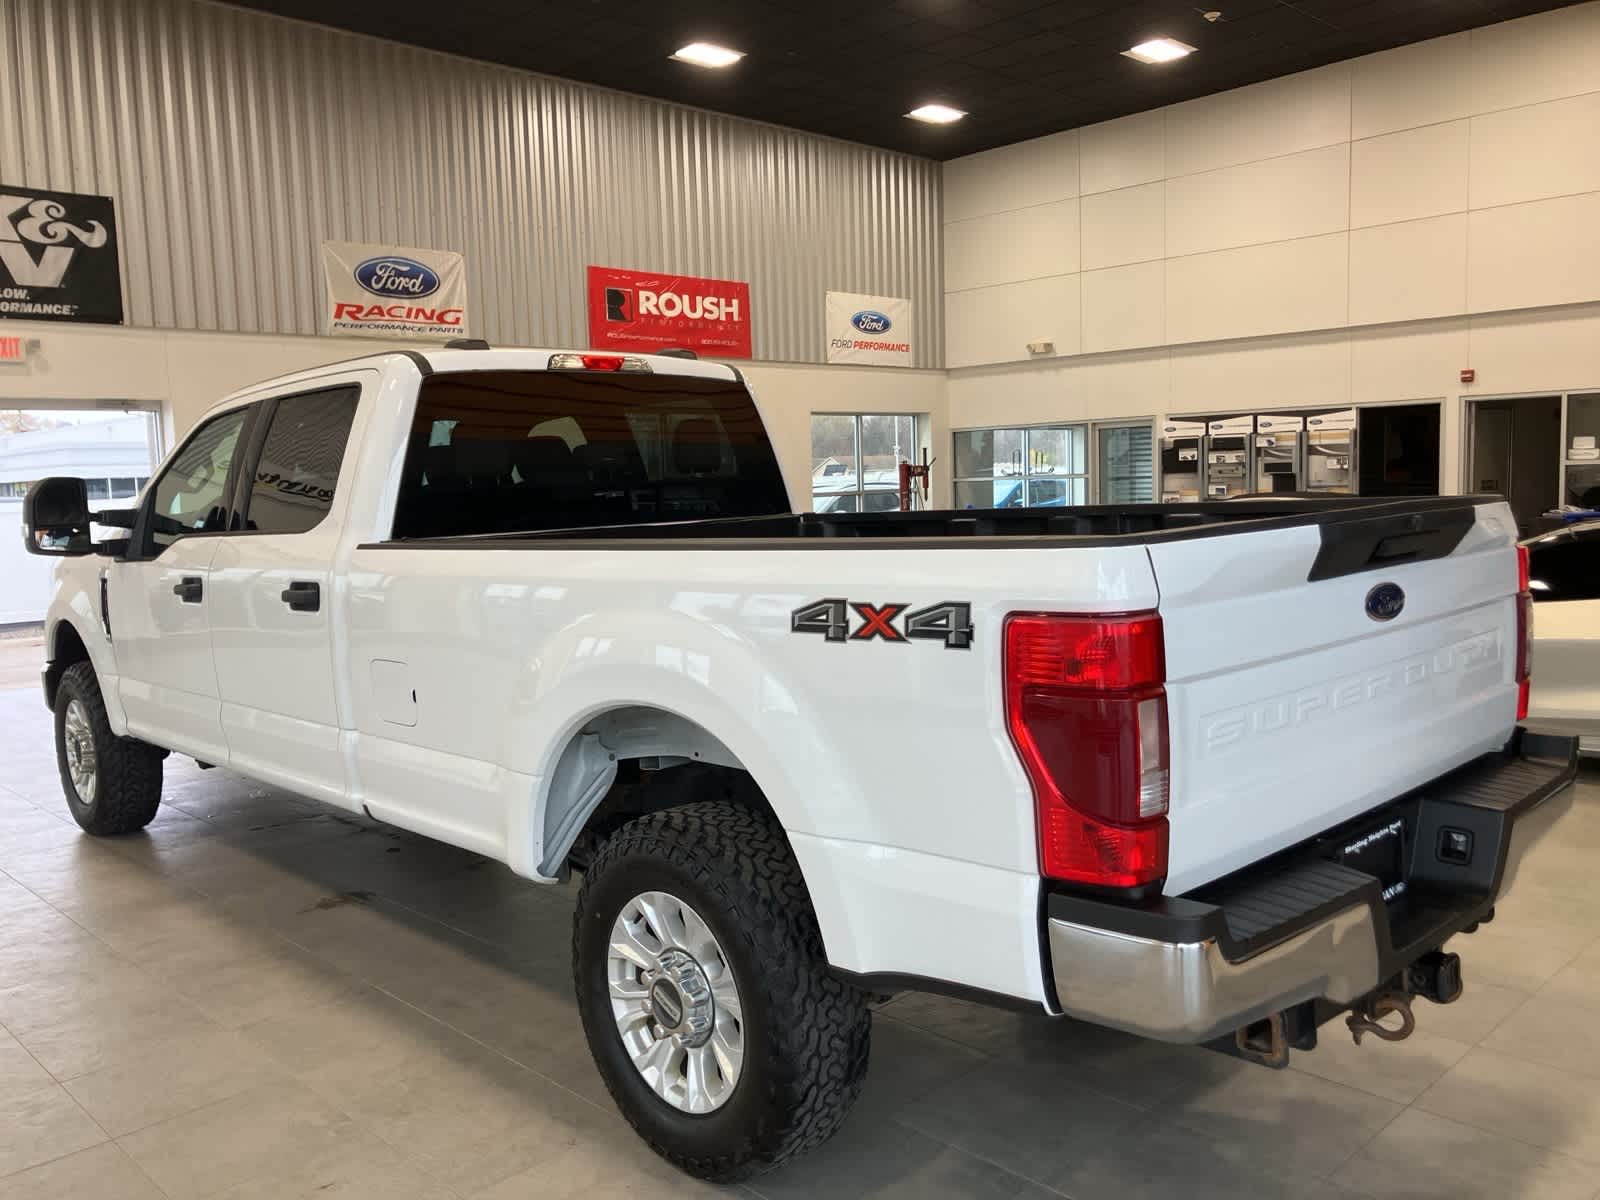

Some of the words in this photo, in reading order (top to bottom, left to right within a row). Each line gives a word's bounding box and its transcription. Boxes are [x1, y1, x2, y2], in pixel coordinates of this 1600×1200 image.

[371, 262, 424, 293] Ford
[334, 303, 464, 325] RACING
[638, 290, 740, 321] ROUSH
[334, 322, 425, 333] PERFORMANCE
[429, 326, 464, 334] PARTS
[859, 314, 884, 330] Ford
[831, 339, 853, 349] FORD
[853, 340, 911, 352] PERFORMANCE
[1206, 673, 1392, 749] SUPER
